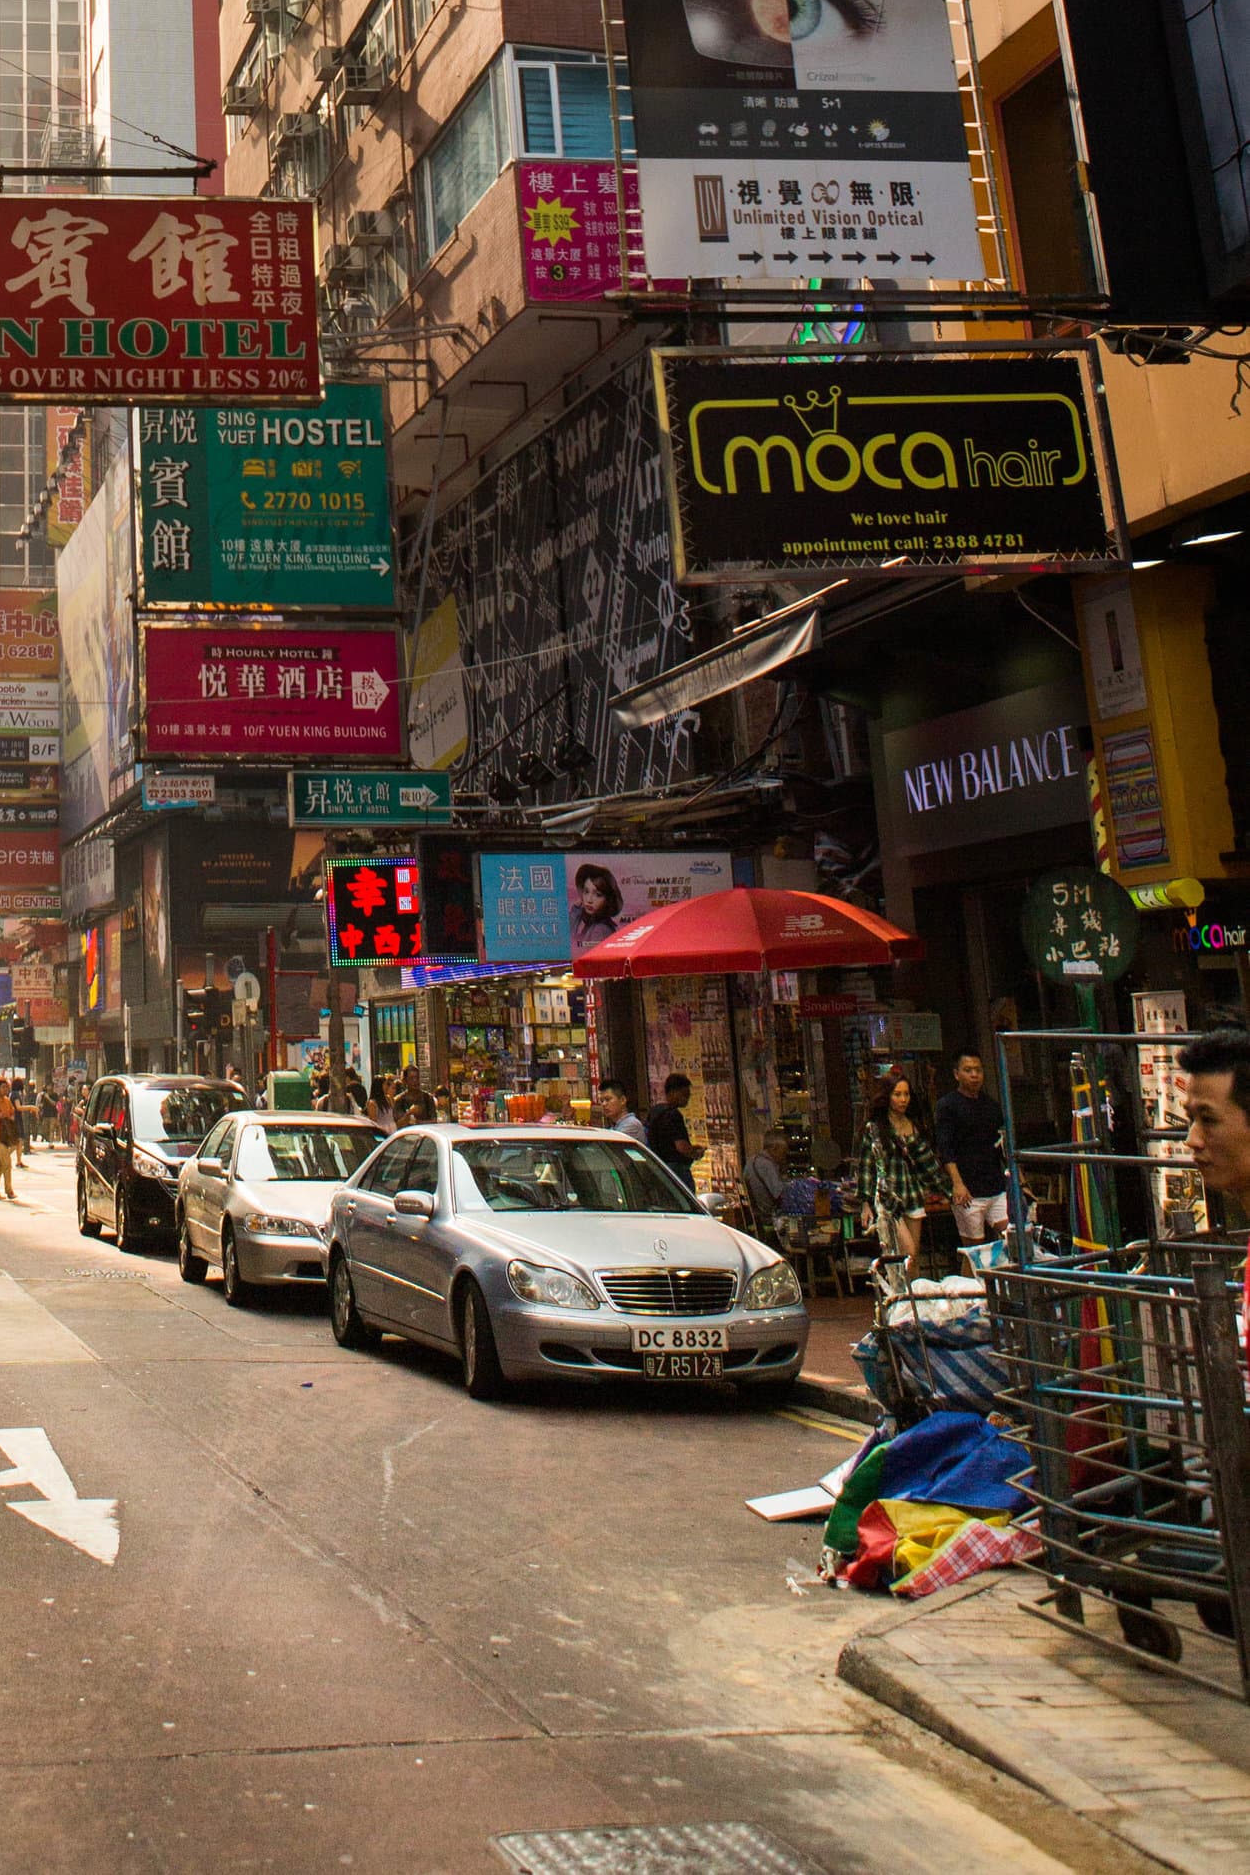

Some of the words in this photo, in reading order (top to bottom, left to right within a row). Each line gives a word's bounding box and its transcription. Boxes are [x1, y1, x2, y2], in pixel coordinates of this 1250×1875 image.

[733, 209, 806, 225] Unlimited
[812, 210, 864, 226] Vision
[867, 210, 924, 227] Optical
[59, 317, 306, 360] HOTEL
[9, 366, 87, 389] OVER
[94, 367, 185, 390] NIGHT
[192, 368, 261, 390] LESS
[267, 368, 308, 390] 20%
[216, 411, 257, 427] SING
[217, 428, 257, 446] YUET
[262, 418, 383, 447] HOSTEL
[722, 431, 959, 494] moca
[963, 438, 1062, 489] hair
[262, 492, 313, 511] 2770
[318, 492, 366, 511] 1015
[850, 512, 876, 526] We
[877, 511, 911, 526] love
[915, 510, 949, 525] hair
[634, 531, 670, 575] Spring
[782, 537, 891, 556] appointment
[894, 535, 930, 552] call:
[932, 533, 980, 551] 2388
[982, 532, 1025, 549] 4781
[220, 552, 246, 564] 10/F
[249, 553, 282, 564] YUEN
[285, 553, 312, 565] KING
[316, 553, 371, 565] BUILDING
[279, 648, 319, 660] HOTEL
[242, 724, 266, 737] 10/F
[268, 725, 300, 737] YUEN
[303, 726, 331, 738] KING
[334, 726, 387, 739] BUILDING
[31, 743, 57, 756] 8/F
[902, 759, 954, 814] NEW
[958, 725, 1080, 802] BALANCE
[13, 894, 62, 911] CENTRE
[1171, 922, 1225, 952] moca
[1224, 924, 1248, 947] hair
[638, 1330, 665, 1348] DC
[672, 1330, 723, 1348] 8832
